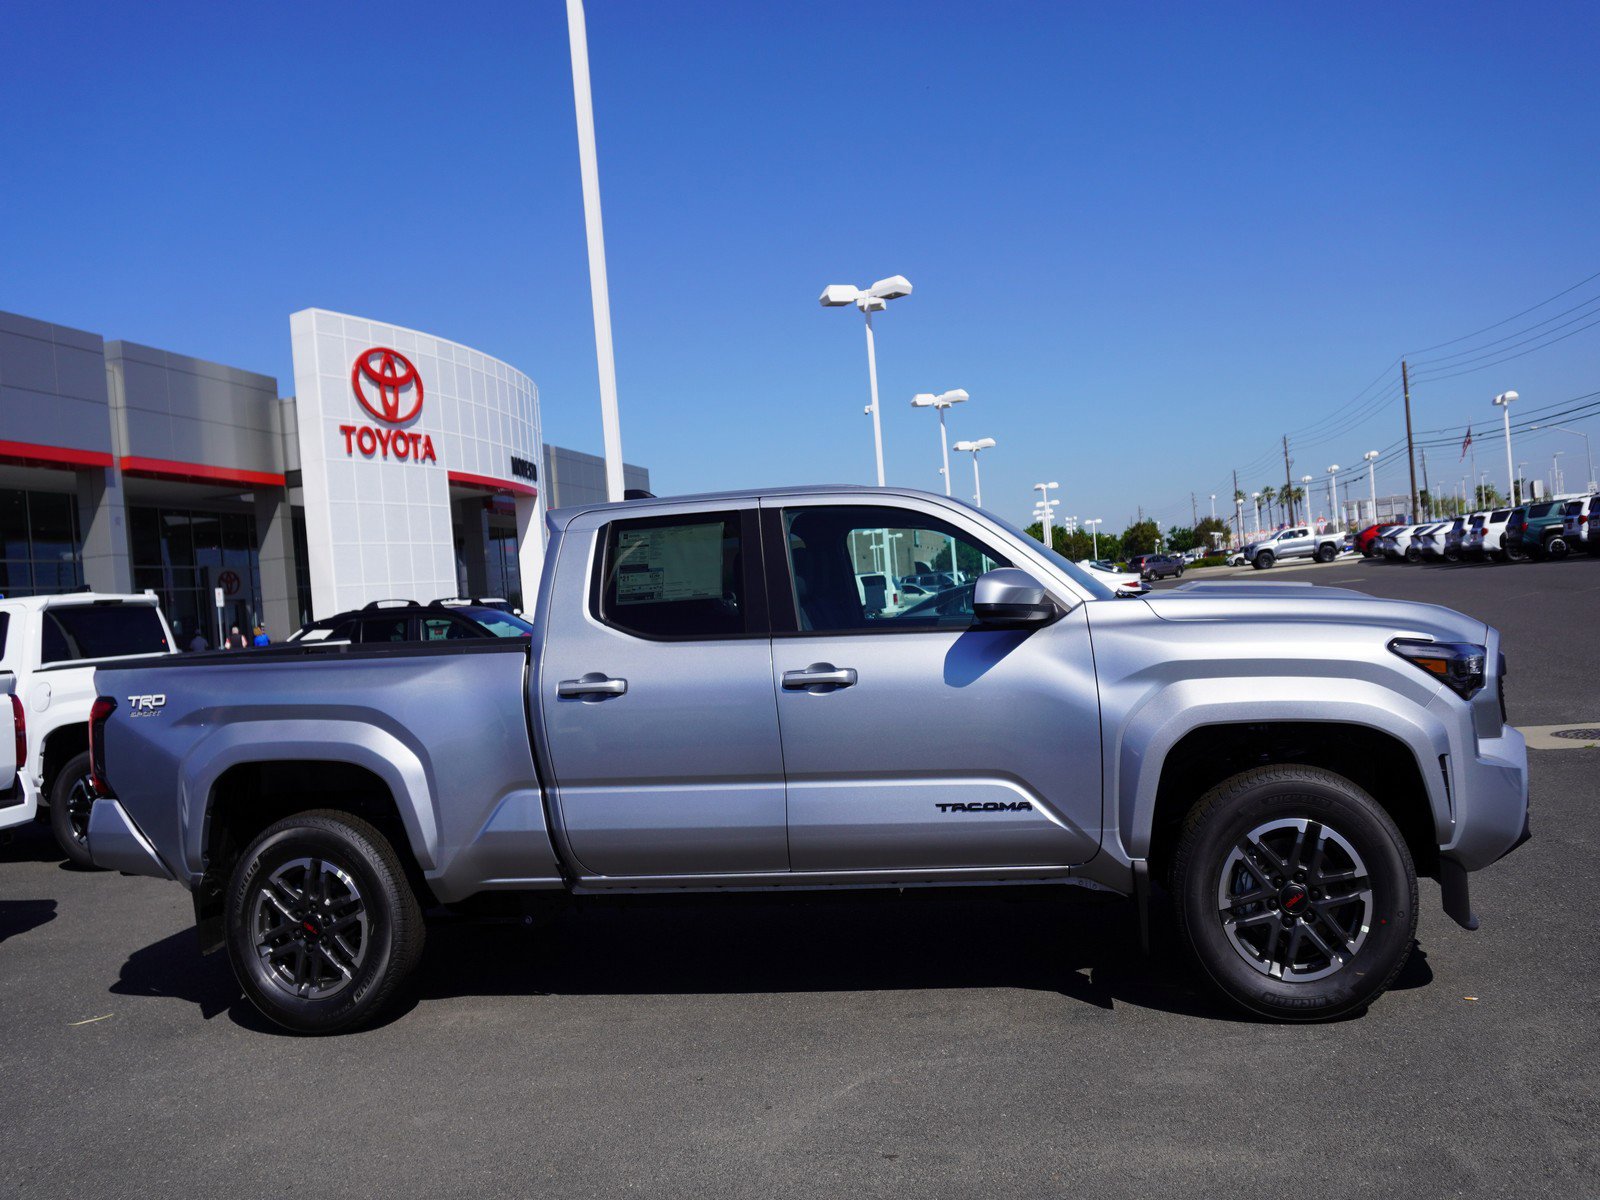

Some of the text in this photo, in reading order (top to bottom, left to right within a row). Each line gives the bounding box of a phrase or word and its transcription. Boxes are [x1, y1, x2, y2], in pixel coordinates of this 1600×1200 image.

[339, 425, 436, 462] TOYOTA
[128, 694, 166, 710] TRD
[935, 801, 1033, 813] TACOMA
[234, 860, 260, 912] MICHELIN
